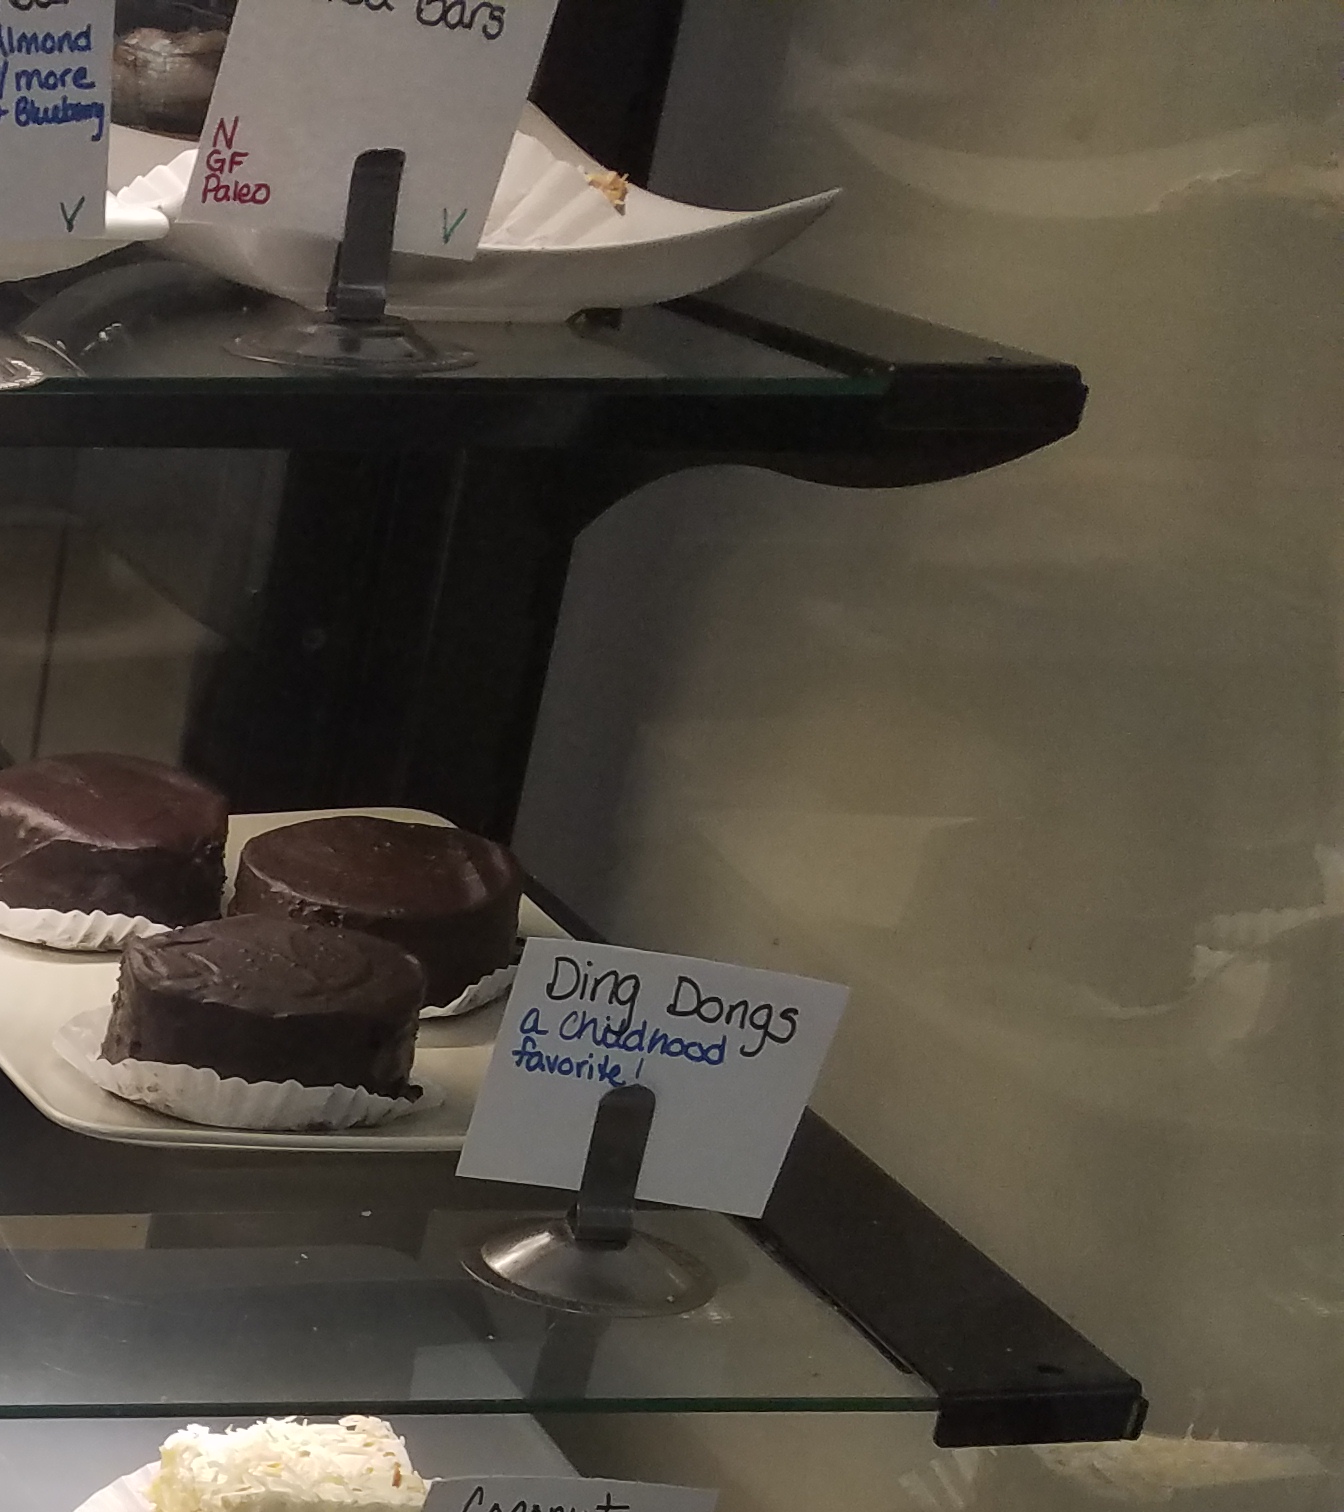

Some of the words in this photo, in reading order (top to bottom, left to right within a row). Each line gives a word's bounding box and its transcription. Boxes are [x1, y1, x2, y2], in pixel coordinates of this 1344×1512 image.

[415, 0, 505, 40] Bars
[15, 65, 96, 91] more
[212, 116, 239, 149] N
[206, 151, 249, 174] GF
[202, 174, 271, 205] Paleo
[60, 196, 86, 233] V
[442, 208, 467, 244] V
[546, 956, 641, 1032] Ding
[667, 975, 799, 1058] Dongs
